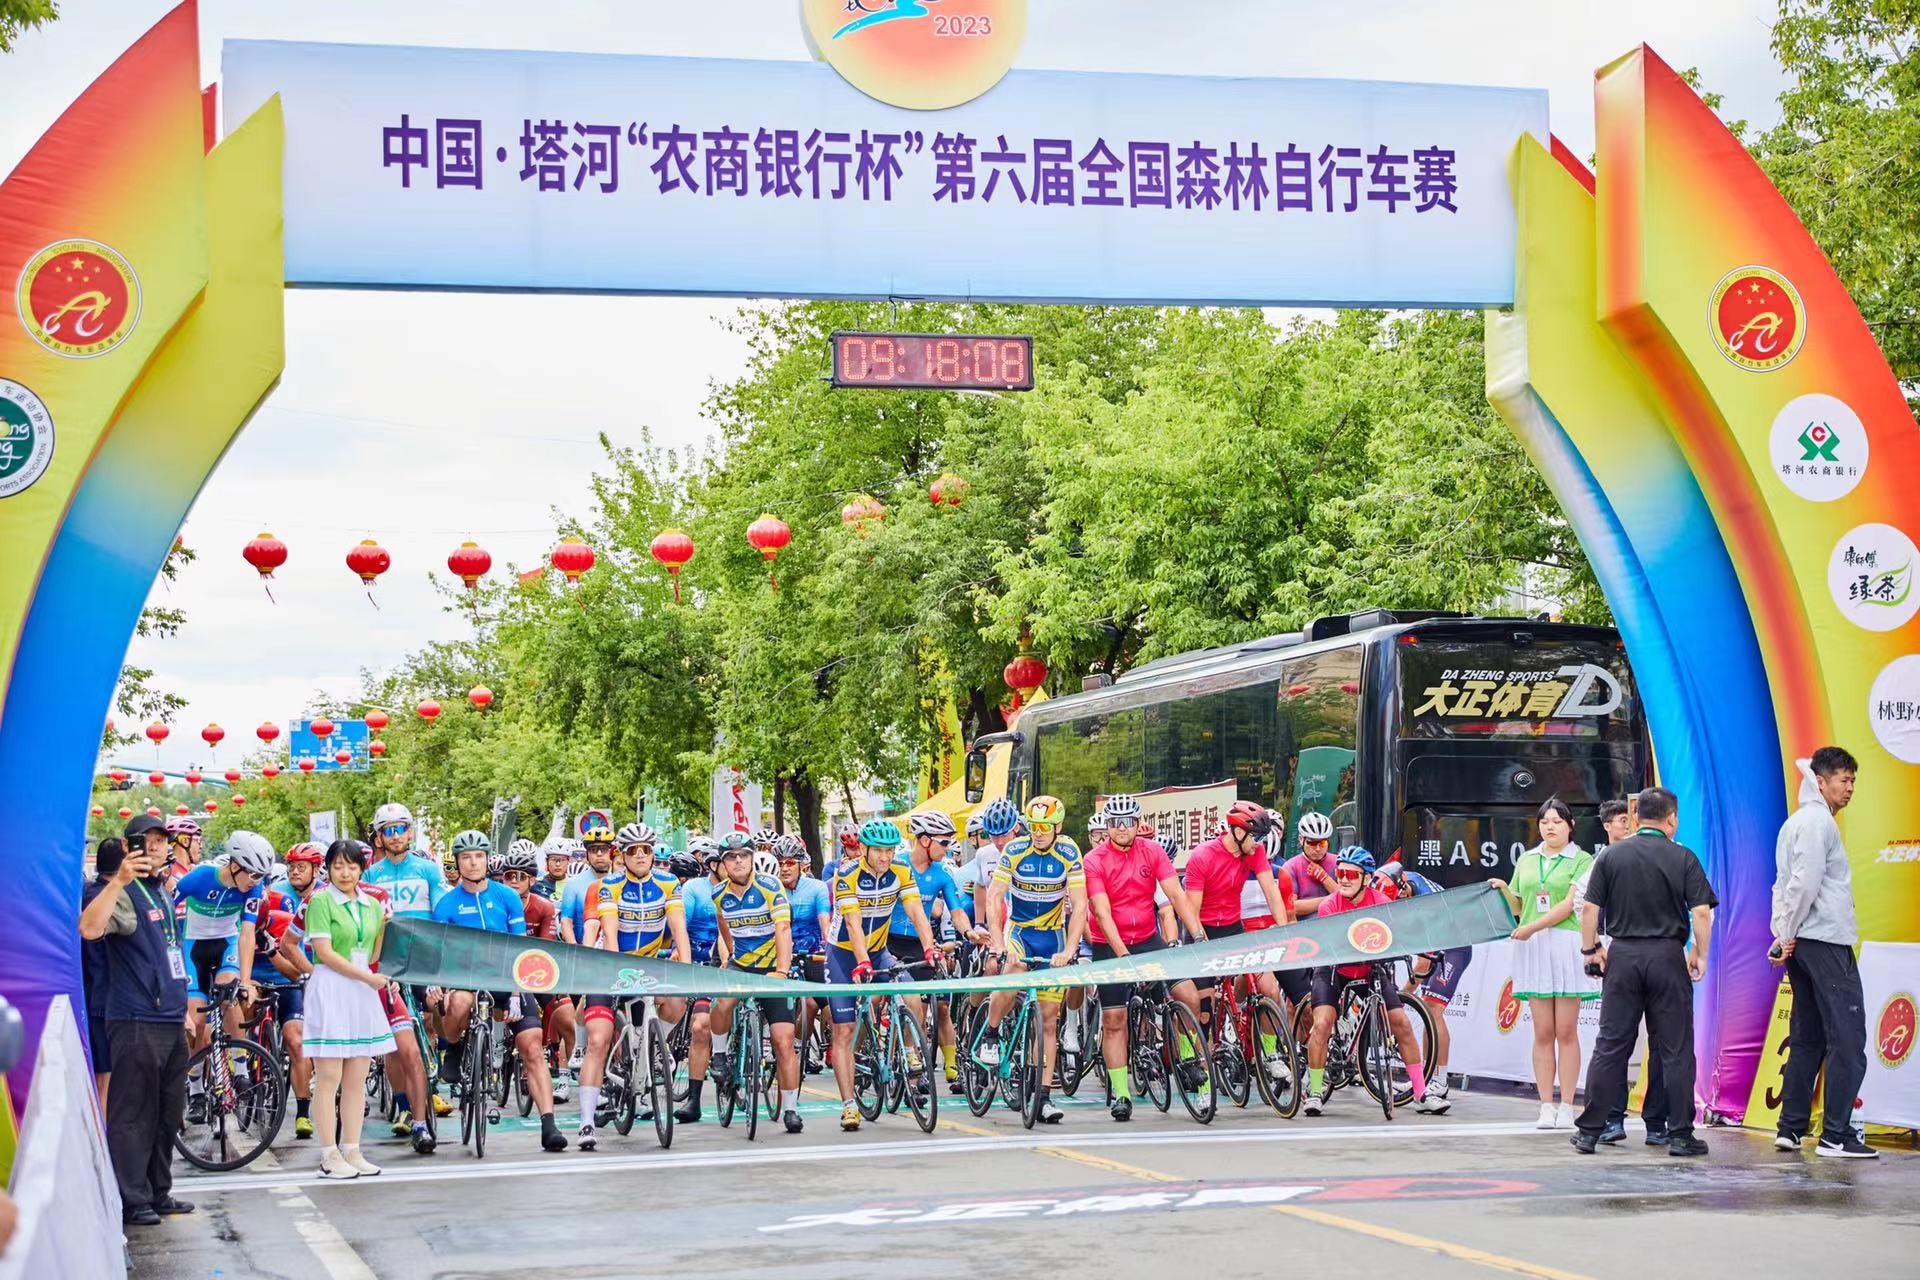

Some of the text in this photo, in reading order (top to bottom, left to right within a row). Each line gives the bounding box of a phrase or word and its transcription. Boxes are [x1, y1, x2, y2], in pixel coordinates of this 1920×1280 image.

[936, 16, 992, 35] 2023
[843, 338, 1024, 383] 09:18:08
[1781, 464, 1857, 477] 塔河农商银行
[1849, 574, 1896, 602] 绿茶
[1440, 669, 1555, 682] DA ZHENG SPORTS
[1413, 680, 1569, 718] 大正体育
[730, 915, 771, 927] ANDEM
[1199, 947, 1287, 972] 大正体育
[1424, 989, 1450, 1003] TREK
[757, 1186, 1325, 1232] 大正体育
